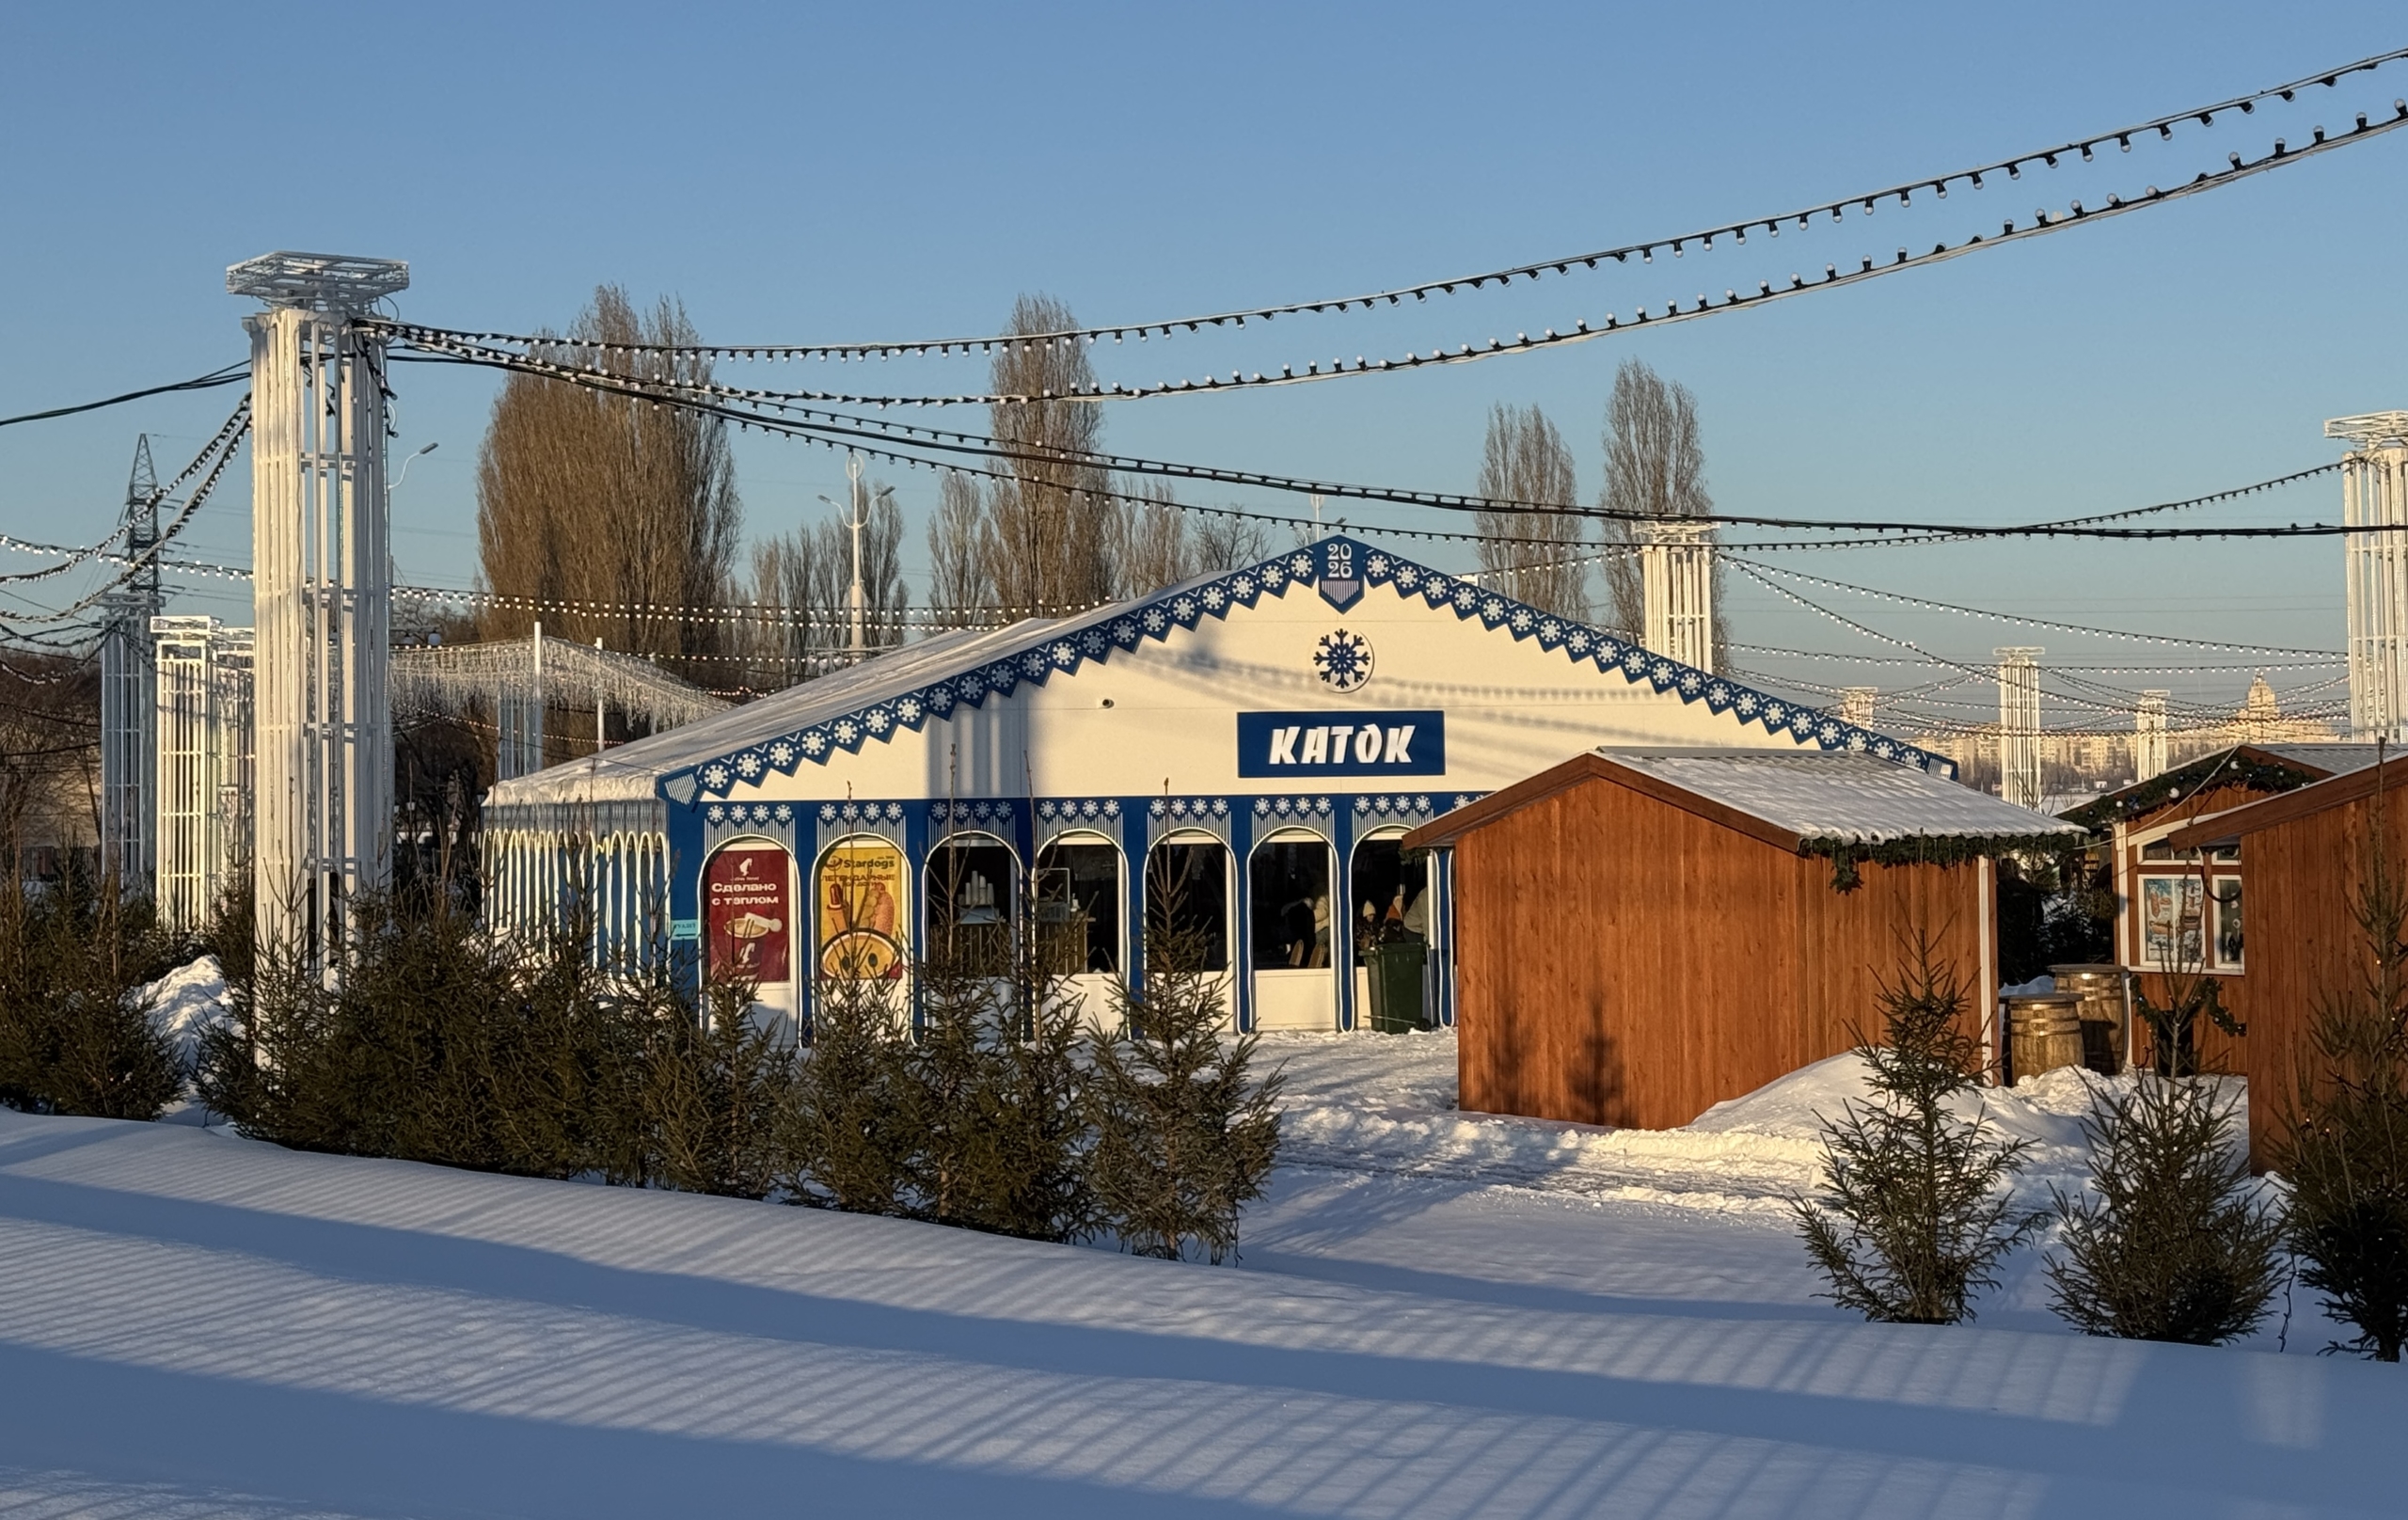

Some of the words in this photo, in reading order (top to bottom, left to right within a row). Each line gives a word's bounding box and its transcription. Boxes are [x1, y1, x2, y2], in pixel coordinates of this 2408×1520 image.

[1327, 543, 1352, 560] 20
[1327, 561, 1353, 578] 26
[1269, 723, 1416, 765] КАТОК
[844, 859, 895, 869] Stardogs
[711, 882, 777, 894] Сделано
[711, 897, 721, 906] с
[722, 896, 779, 906] теплом
